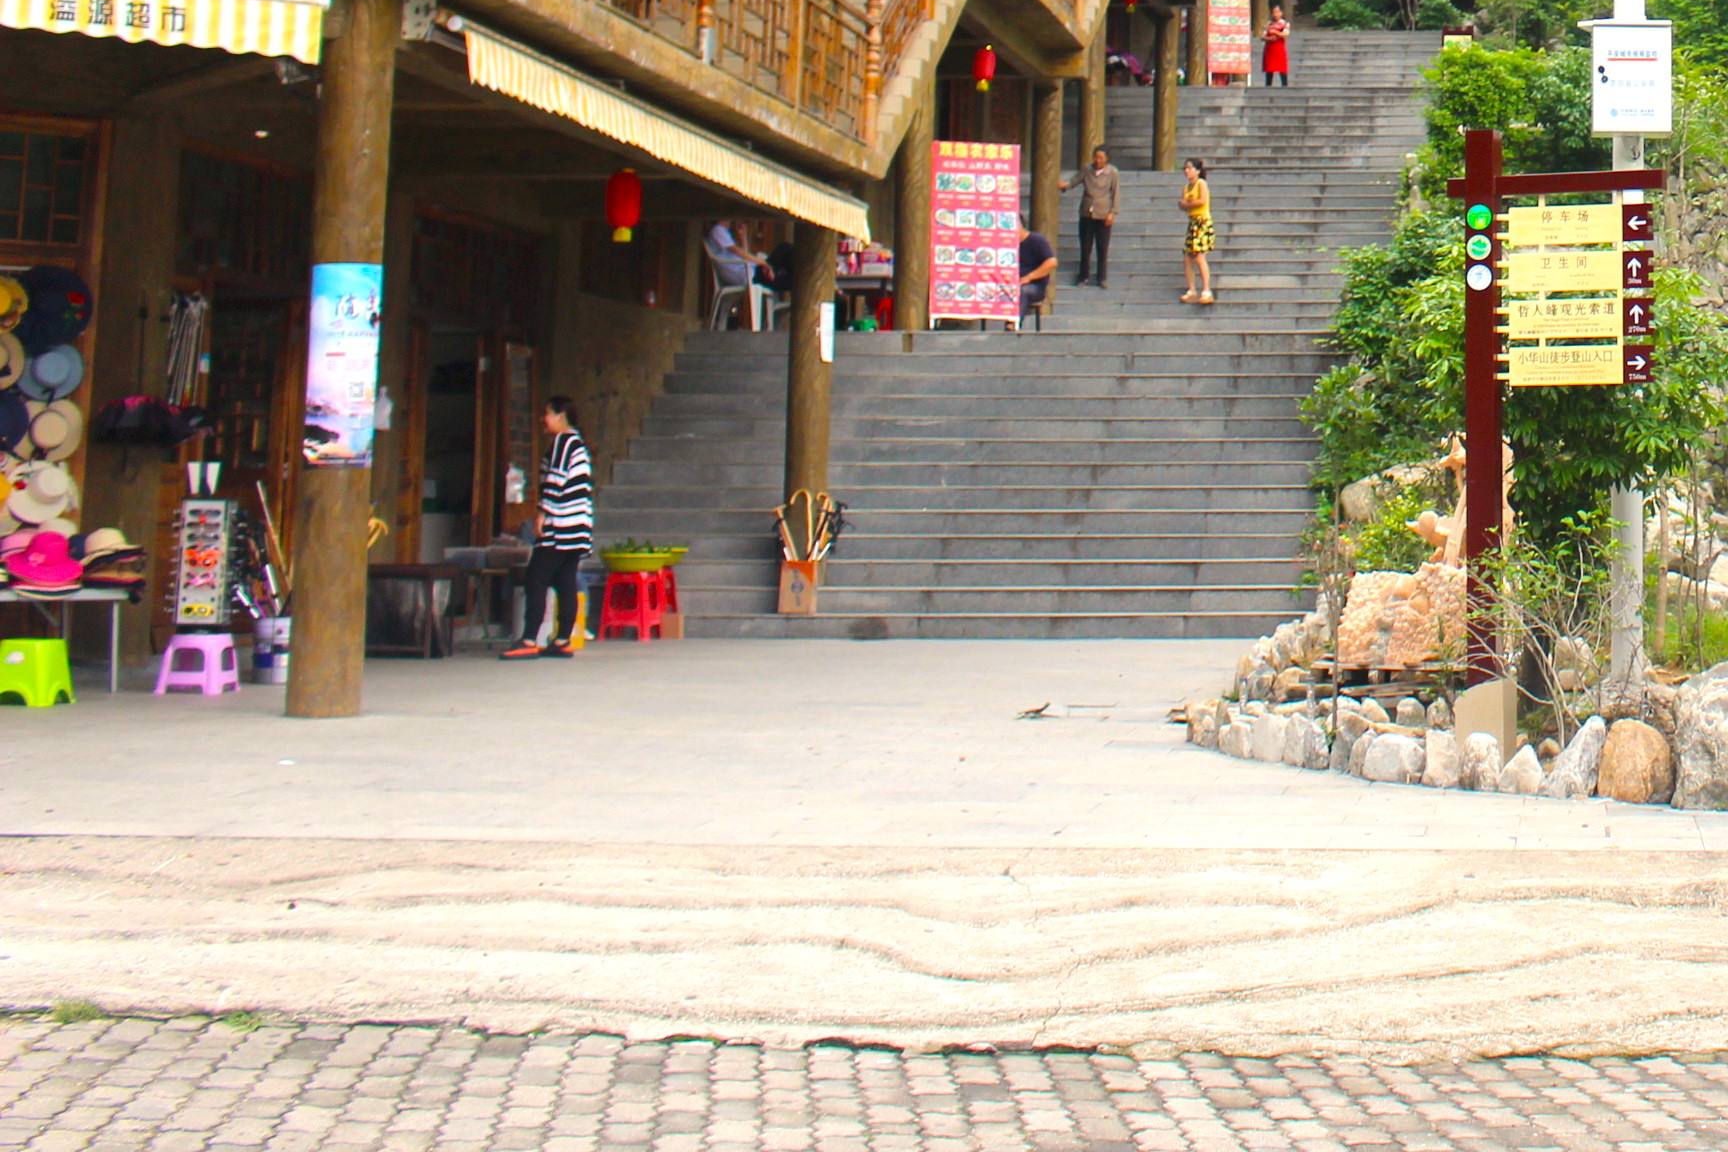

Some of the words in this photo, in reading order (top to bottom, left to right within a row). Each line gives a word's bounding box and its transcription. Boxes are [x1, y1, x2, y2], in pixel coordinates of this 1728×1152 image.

[1541, 210, 1589, 224] 停车场
[1540, 256, 1588, 269] 卫生间
[1518, 302, 1616, 318] 哲人峰观光索道
[1519, 350, 1614, 365] 小华山徒步登山入口
